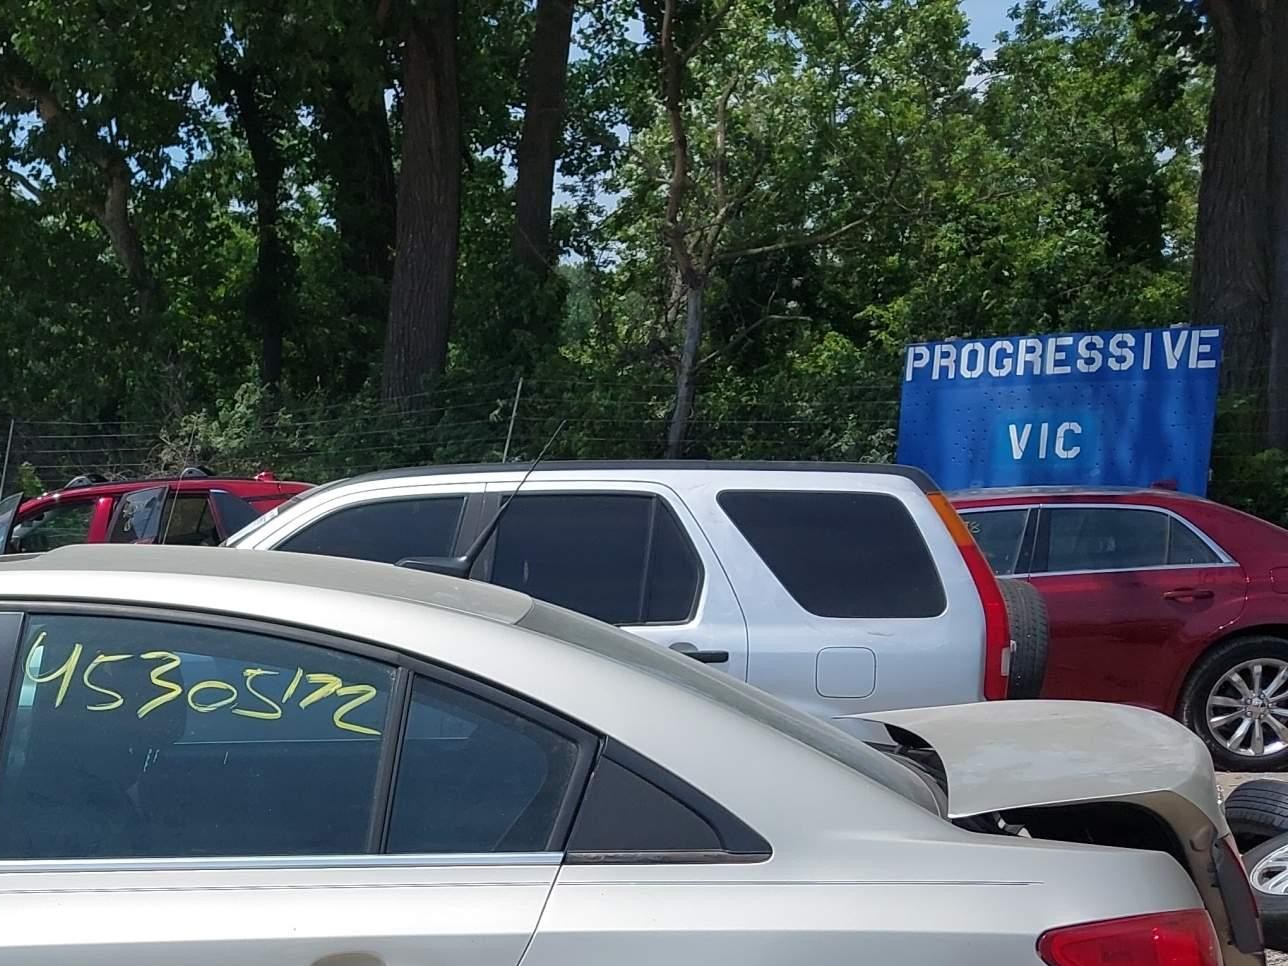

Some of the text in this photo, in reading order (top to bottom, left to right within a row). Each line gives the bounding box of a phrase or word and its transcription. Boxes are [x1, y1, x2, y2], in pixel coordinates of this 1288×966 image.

[905, 328, 1220, 382] PROGRESSIVE
[1008, 421, 1083, 460] VIC
[23, 629, 383, 737] 45305172
